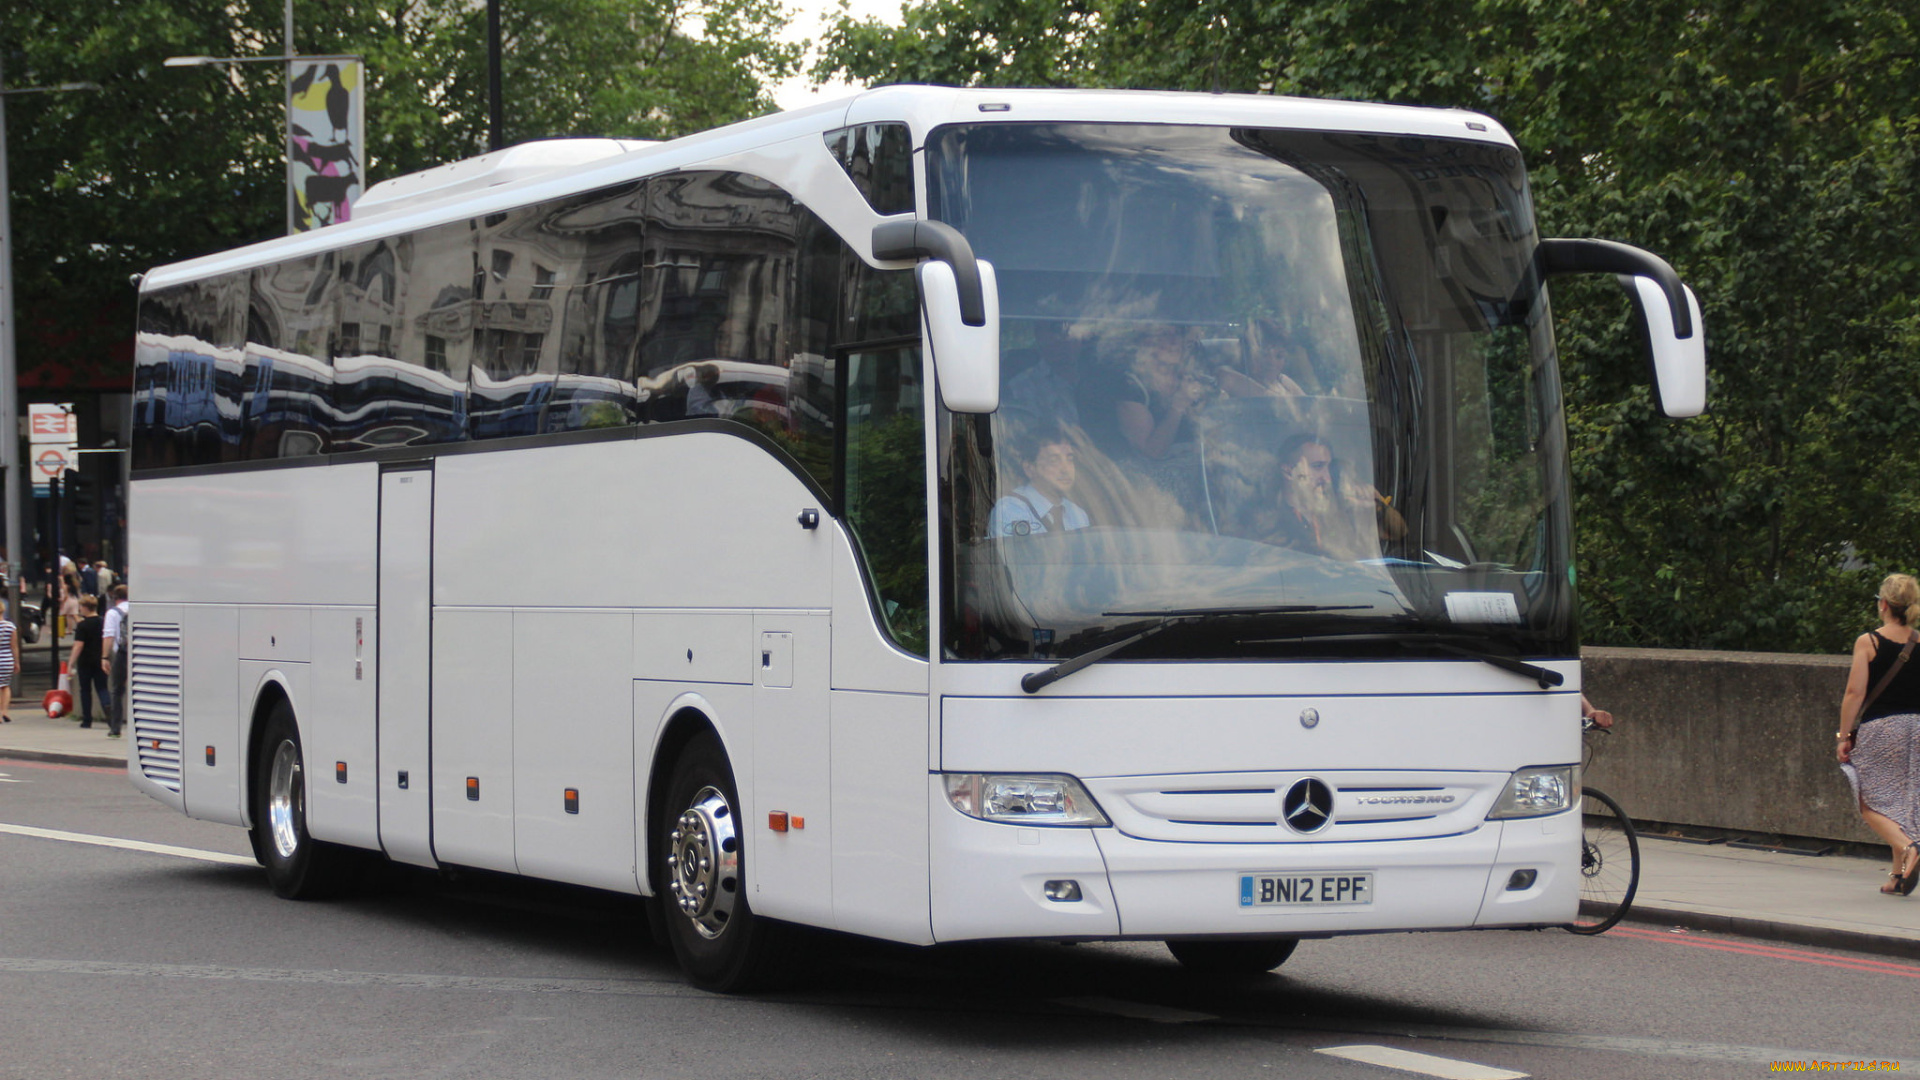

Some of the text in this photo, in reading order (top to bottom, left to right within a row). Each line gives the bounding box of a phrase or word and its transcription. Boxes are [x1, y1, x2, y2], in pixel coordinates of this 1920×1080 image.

[1356, 794, 1456, 805] TOURISMO
[1260, 876, 1366, 903] BN12 EPF
